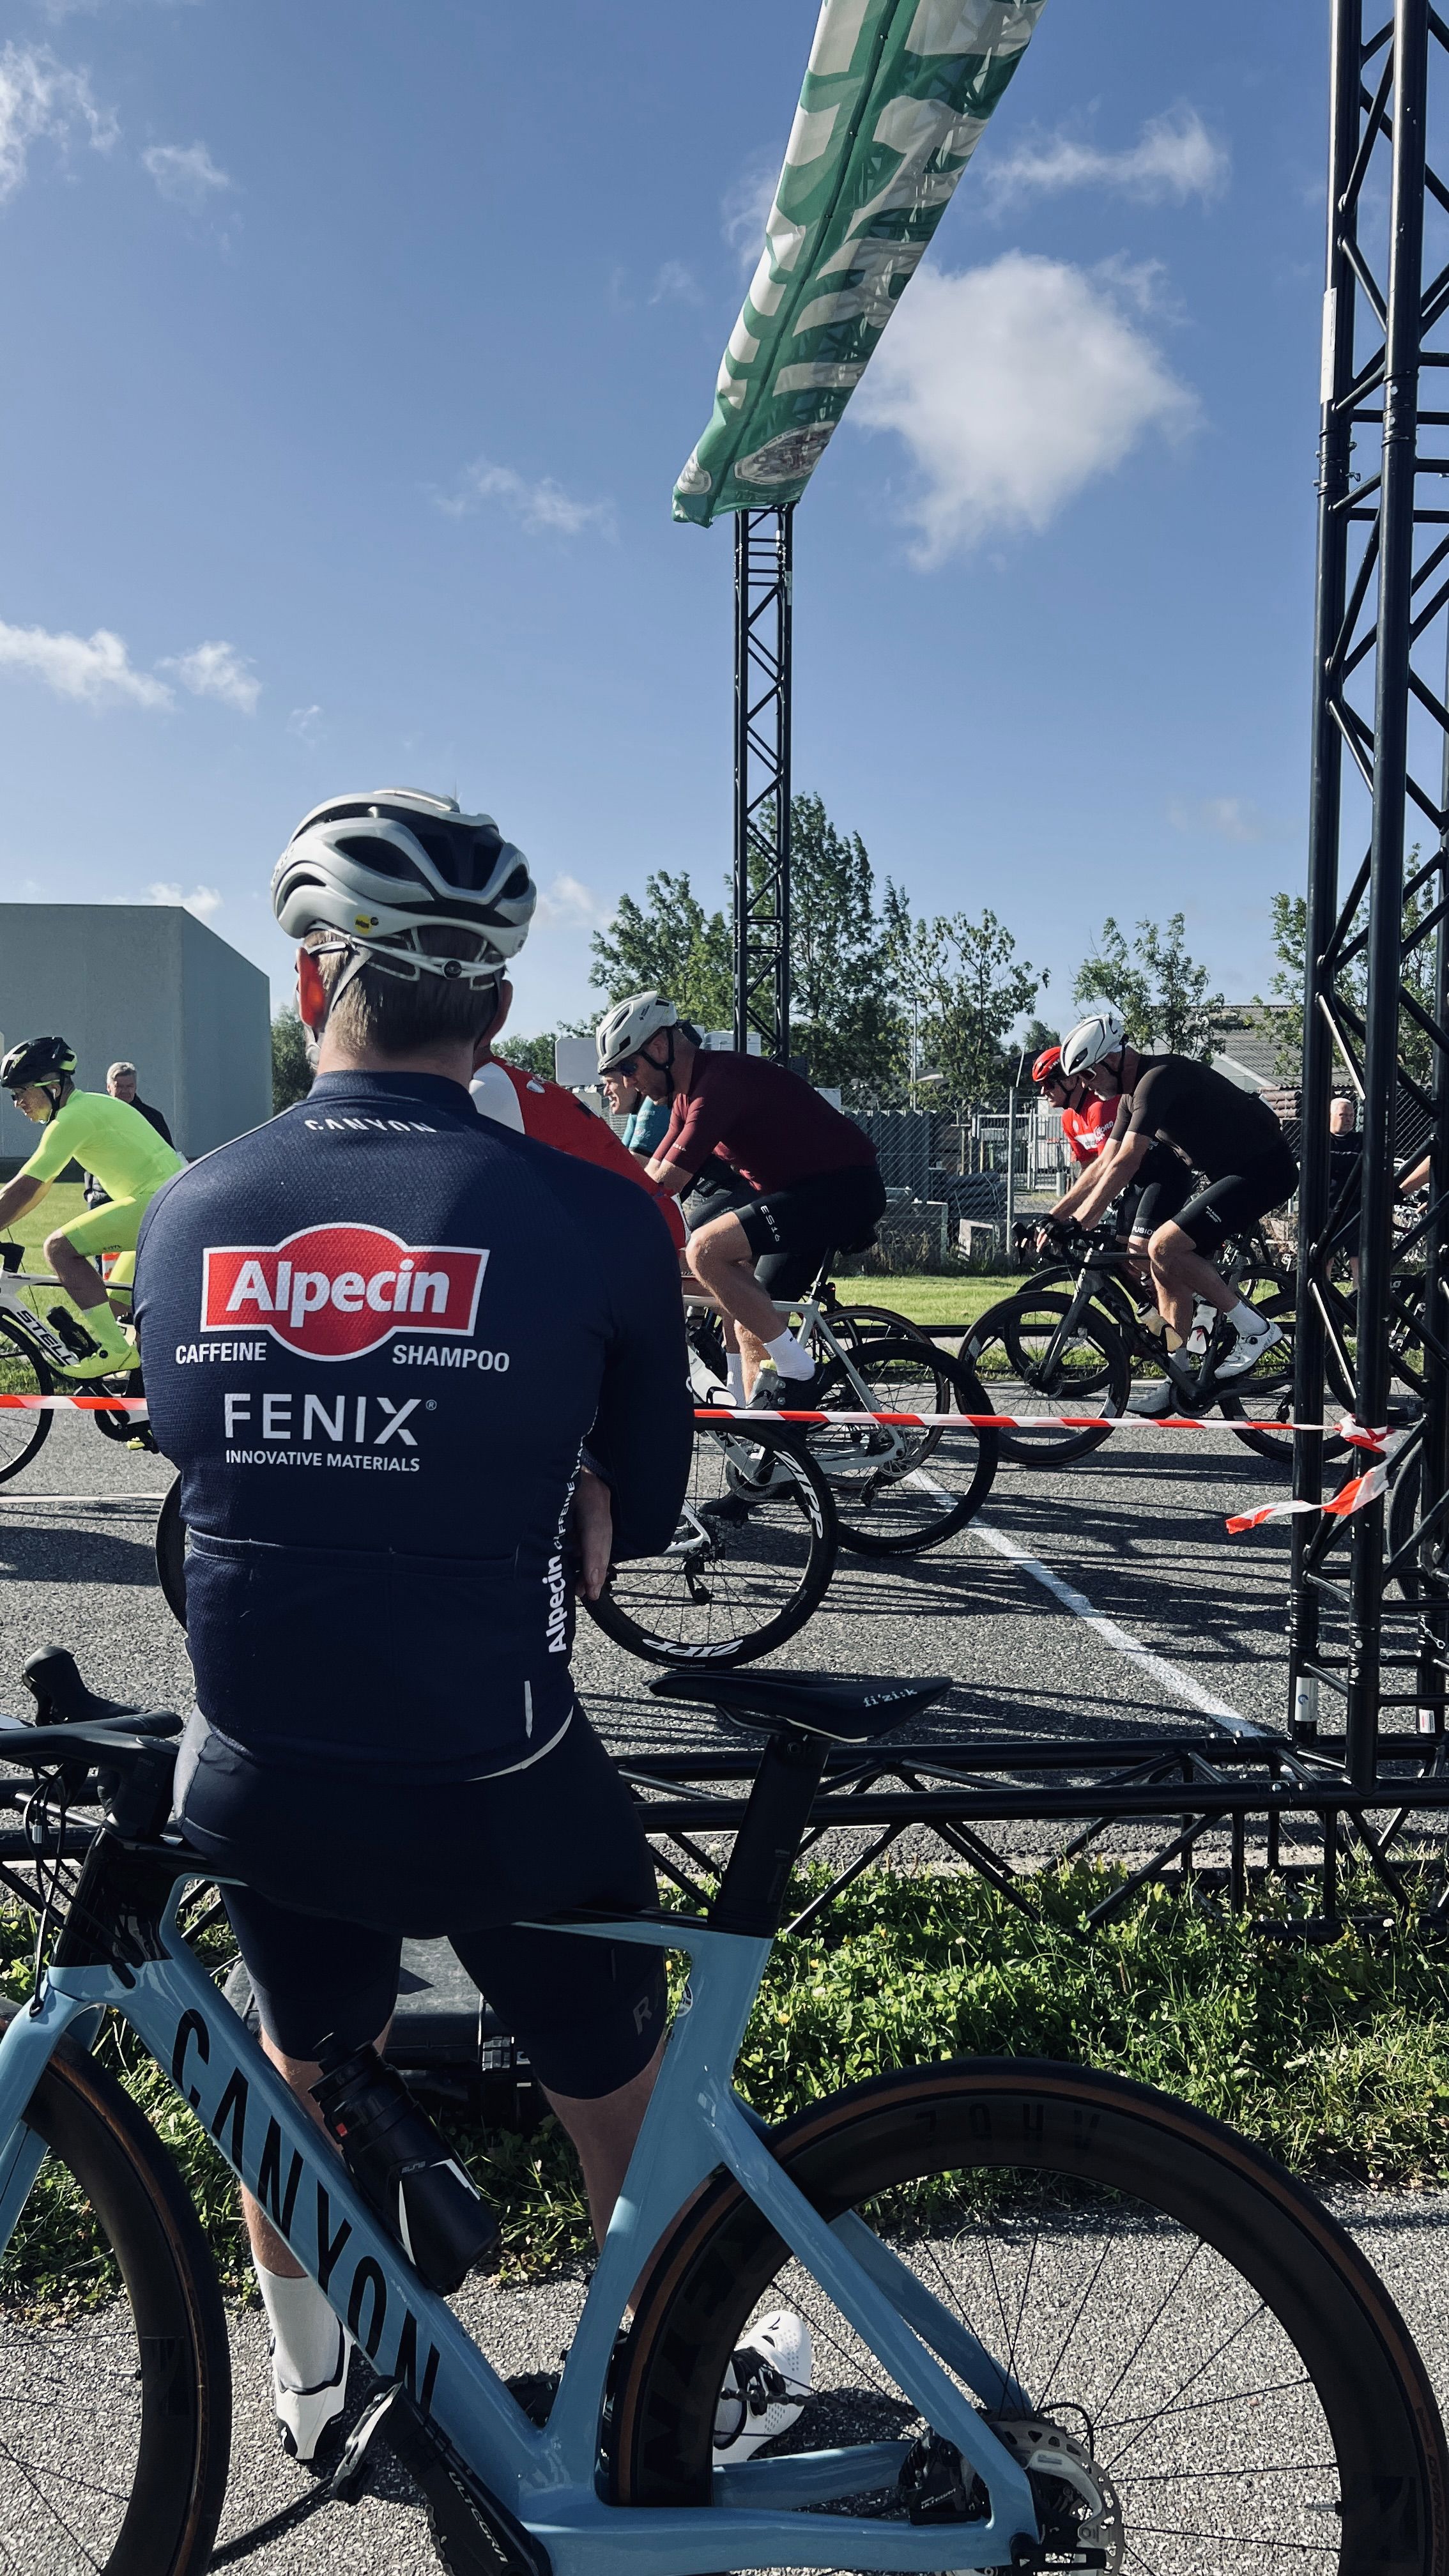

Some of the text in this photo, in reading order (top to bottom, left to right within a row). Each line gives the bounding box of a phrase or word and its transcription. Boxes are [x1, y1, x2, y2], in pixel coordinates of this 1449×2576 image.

[304, 1118, 437, 1133] CANYON
[760, 1205, 781, 1242] ES16
[226, 1259, 450, 1328] Alpecin
[175, 1342, 510, 1372] CAFFEINE SHAMPOO
[225, 1449, 420, 1473] INNOVATIVE MATERIALS
[773, 1450, 824, 1539] ZIPP
[542, 1555, 568, 1653] Alpecin
[642, 1639, 744, 1657] ZIPP
[172, 2008, 440, 2416] CANYON
[448, 2471, 509, 2563] ULTEGRA
